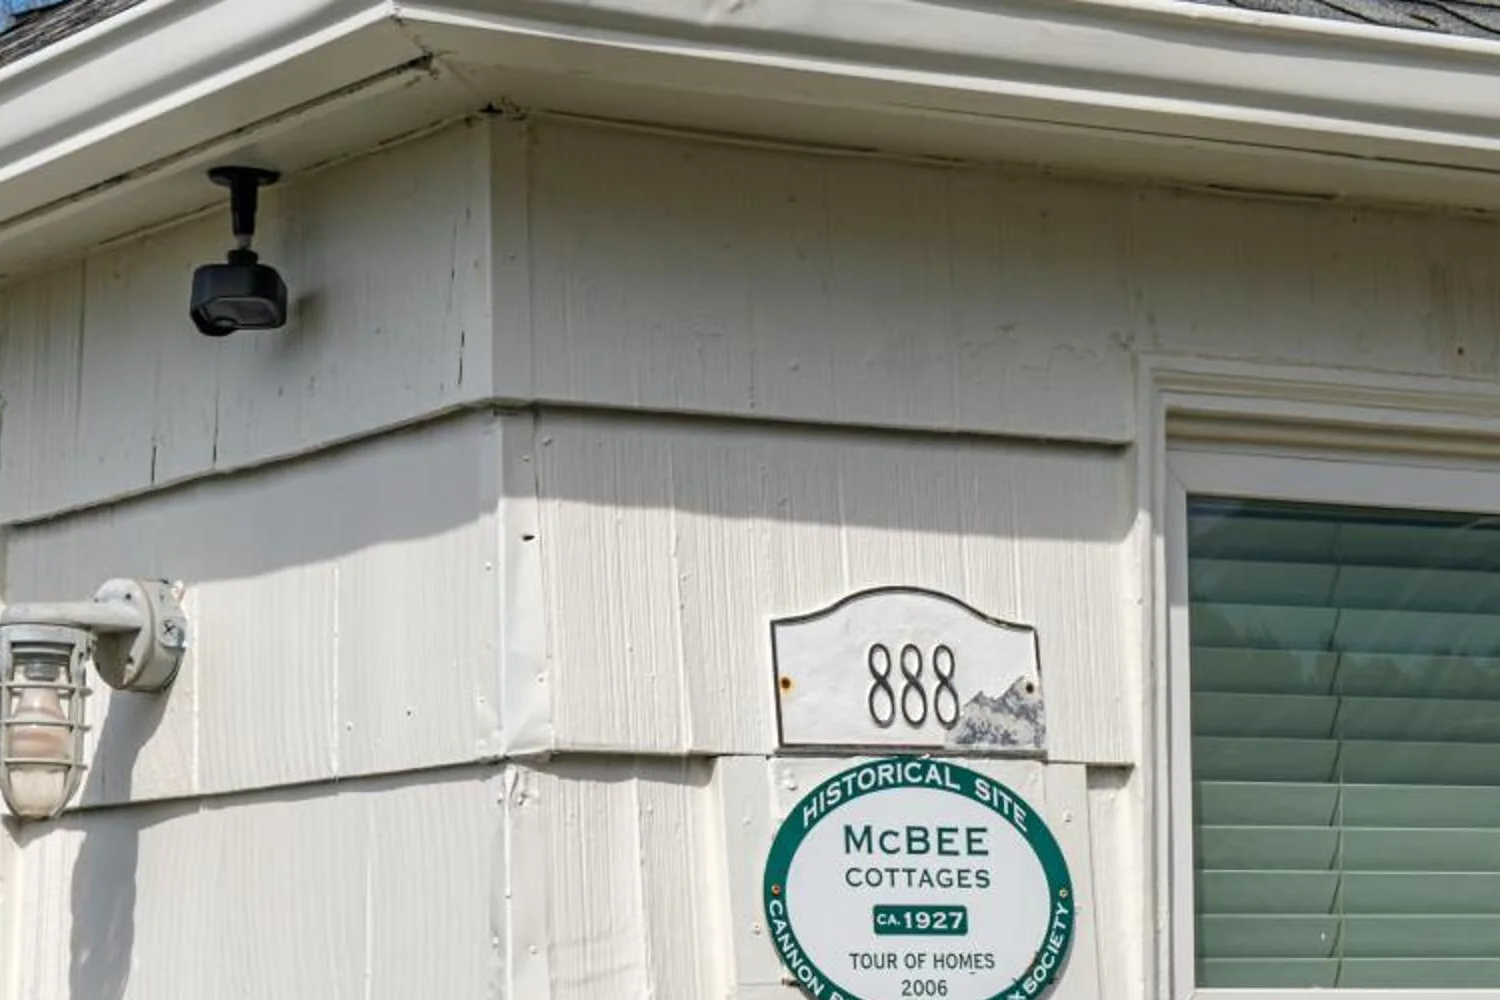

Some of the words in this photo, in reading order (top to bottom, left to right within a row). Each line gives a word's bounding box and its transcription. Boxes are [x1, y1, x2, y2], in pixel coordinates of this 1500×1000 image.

[868, 643, 960, 730] 888
[803, 762, 960, 828] HISTORICAL
[974, 779, 1028, 832] SITE
[843, 825, 990, 856] McBEE
[845, 867, 991, 888] COTTAGES
[876, 913, 901, 926] CA.
[903, 911, 964, 930] 1927
[769, 900, 825, 997] CANNON
[849, 952, 898, 970] TOUR
[904, 952, 928, 970] OF
[933, 952, 996, 971] HOMES
[901, 979, 948, 997] 2006
